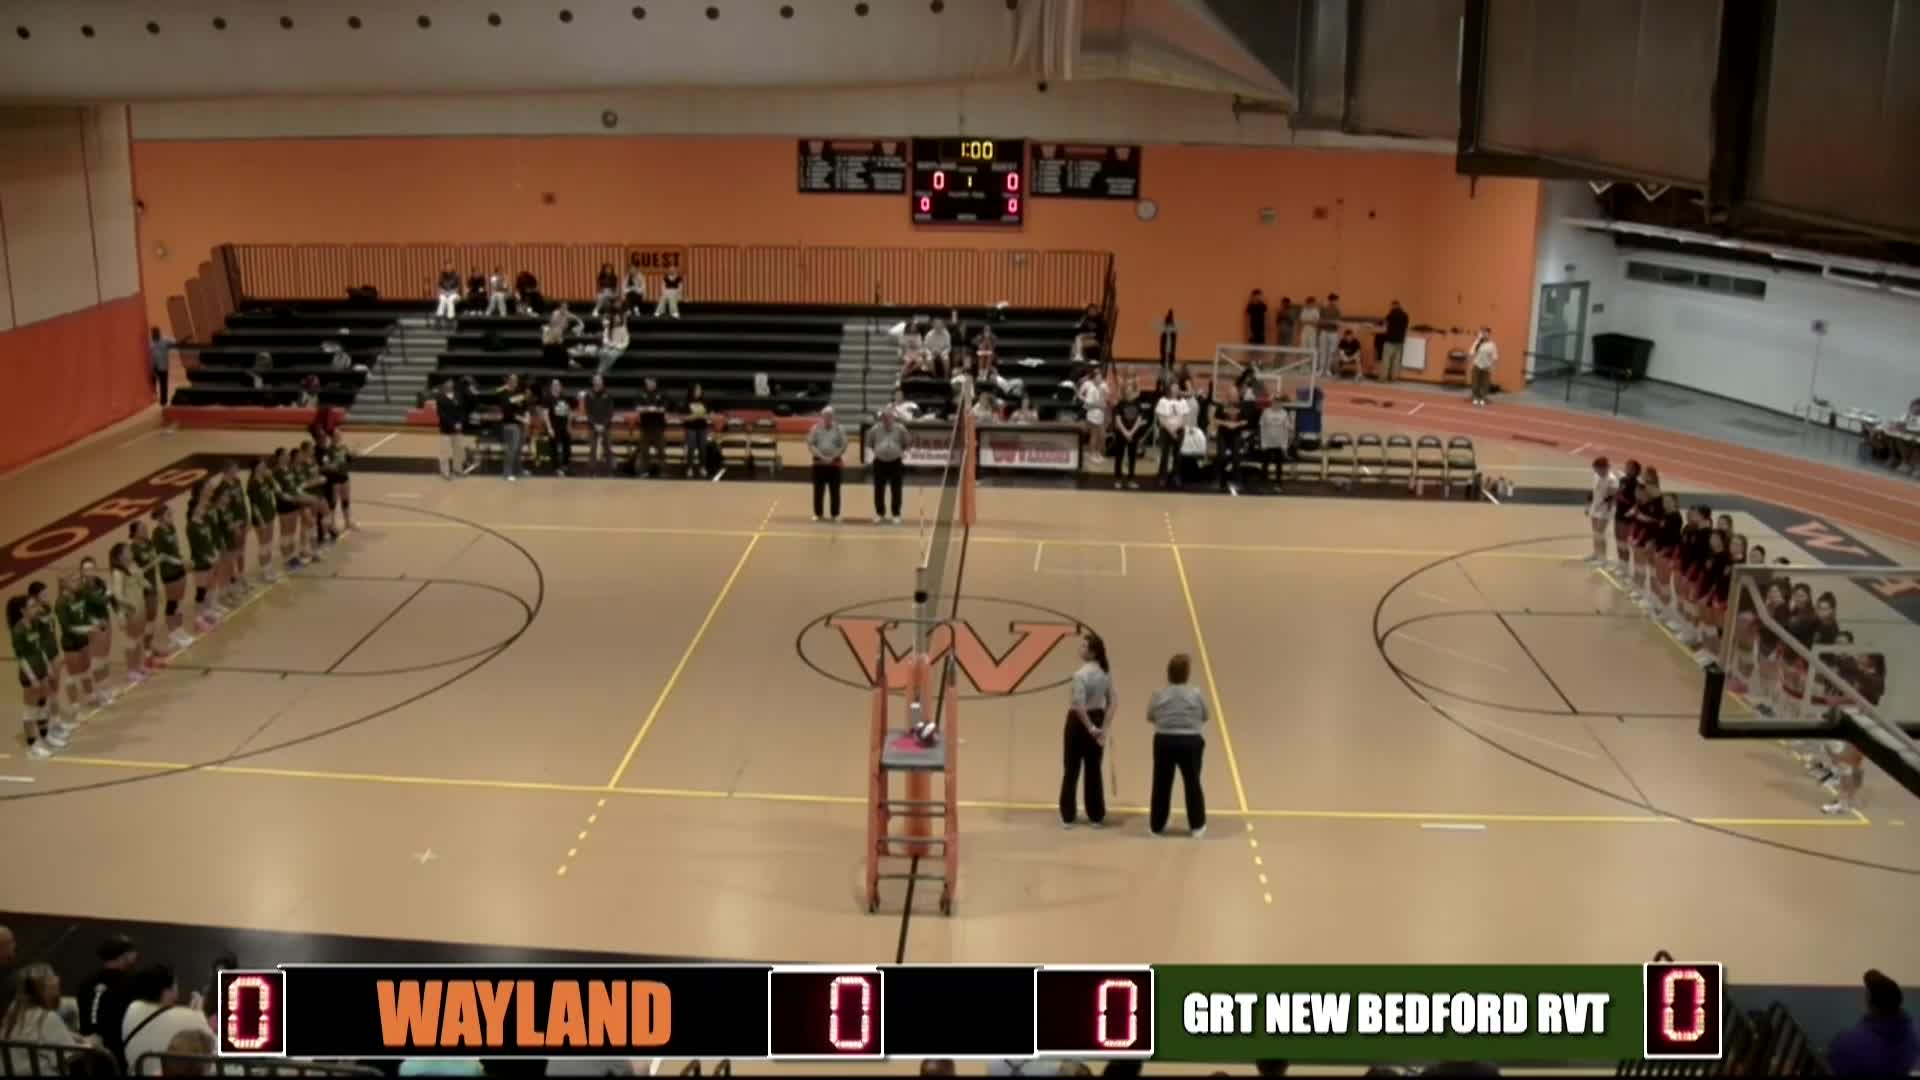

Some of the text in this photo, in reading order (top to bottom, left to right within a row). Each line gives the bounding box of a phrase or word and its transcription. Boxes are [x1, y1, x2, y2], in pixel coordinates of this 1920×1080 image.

[961, 141, 993, 160] 1:00
[933, 170, 945, 191] 0
[1007, 172, 1019, 191] 0
[920, 196, 930, 212] 0
[1007, 198, 1018, 213] 0
[631, 251, 680, 268] GUEST
[825, 614, 1081, 694] W
